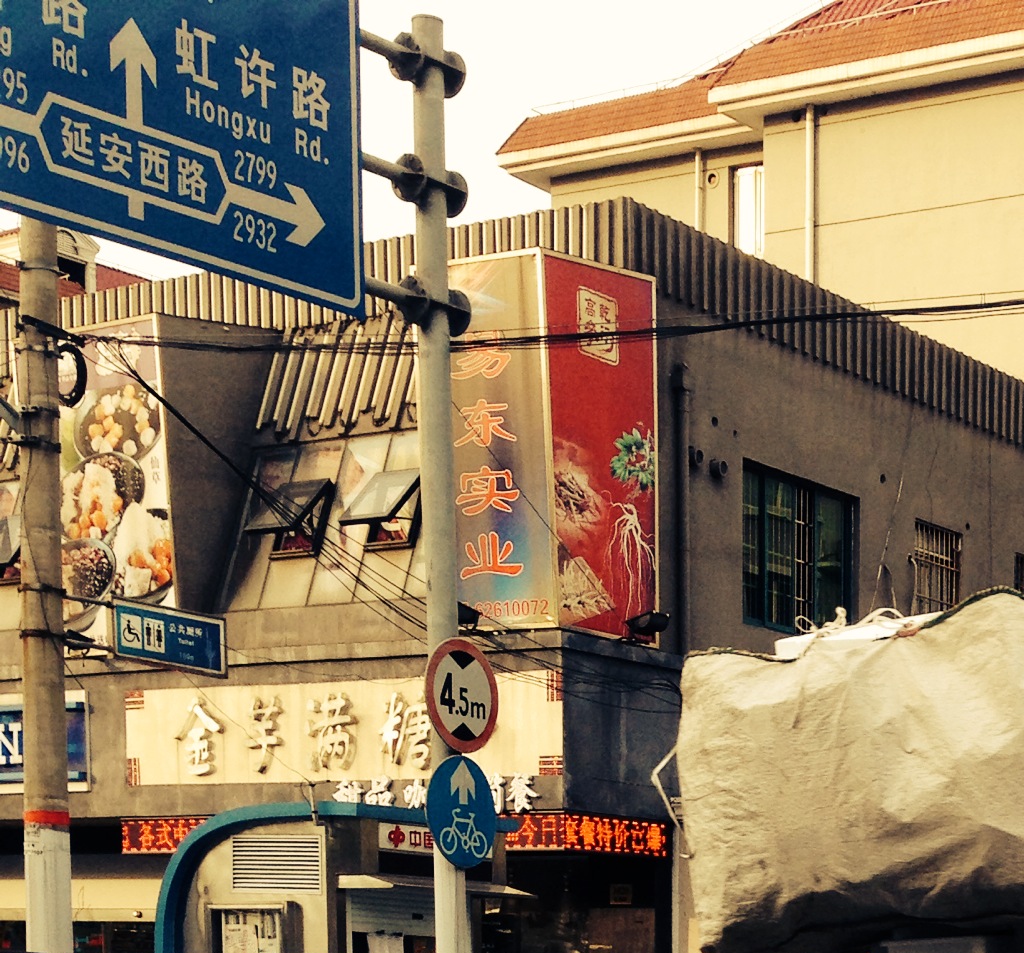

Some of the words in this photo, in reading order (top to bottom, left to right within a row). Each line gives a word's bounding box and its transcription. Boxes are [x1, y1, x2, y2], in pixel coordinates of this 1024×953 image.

[52, 36, 88, 78] Rd.
[174, 18, 331, 131] 虹许路
[184, 86, 272, 145] Hongxu
[294, 128, 330, 166] Rd.
[0, 135, 30, 173] 96
[60, 115, 208, 205] 延安西路
[234, 149, 278, 190] 2799
[233, 211, 278, 254] 2932
[439, 672, 487, 721] 4.5m
